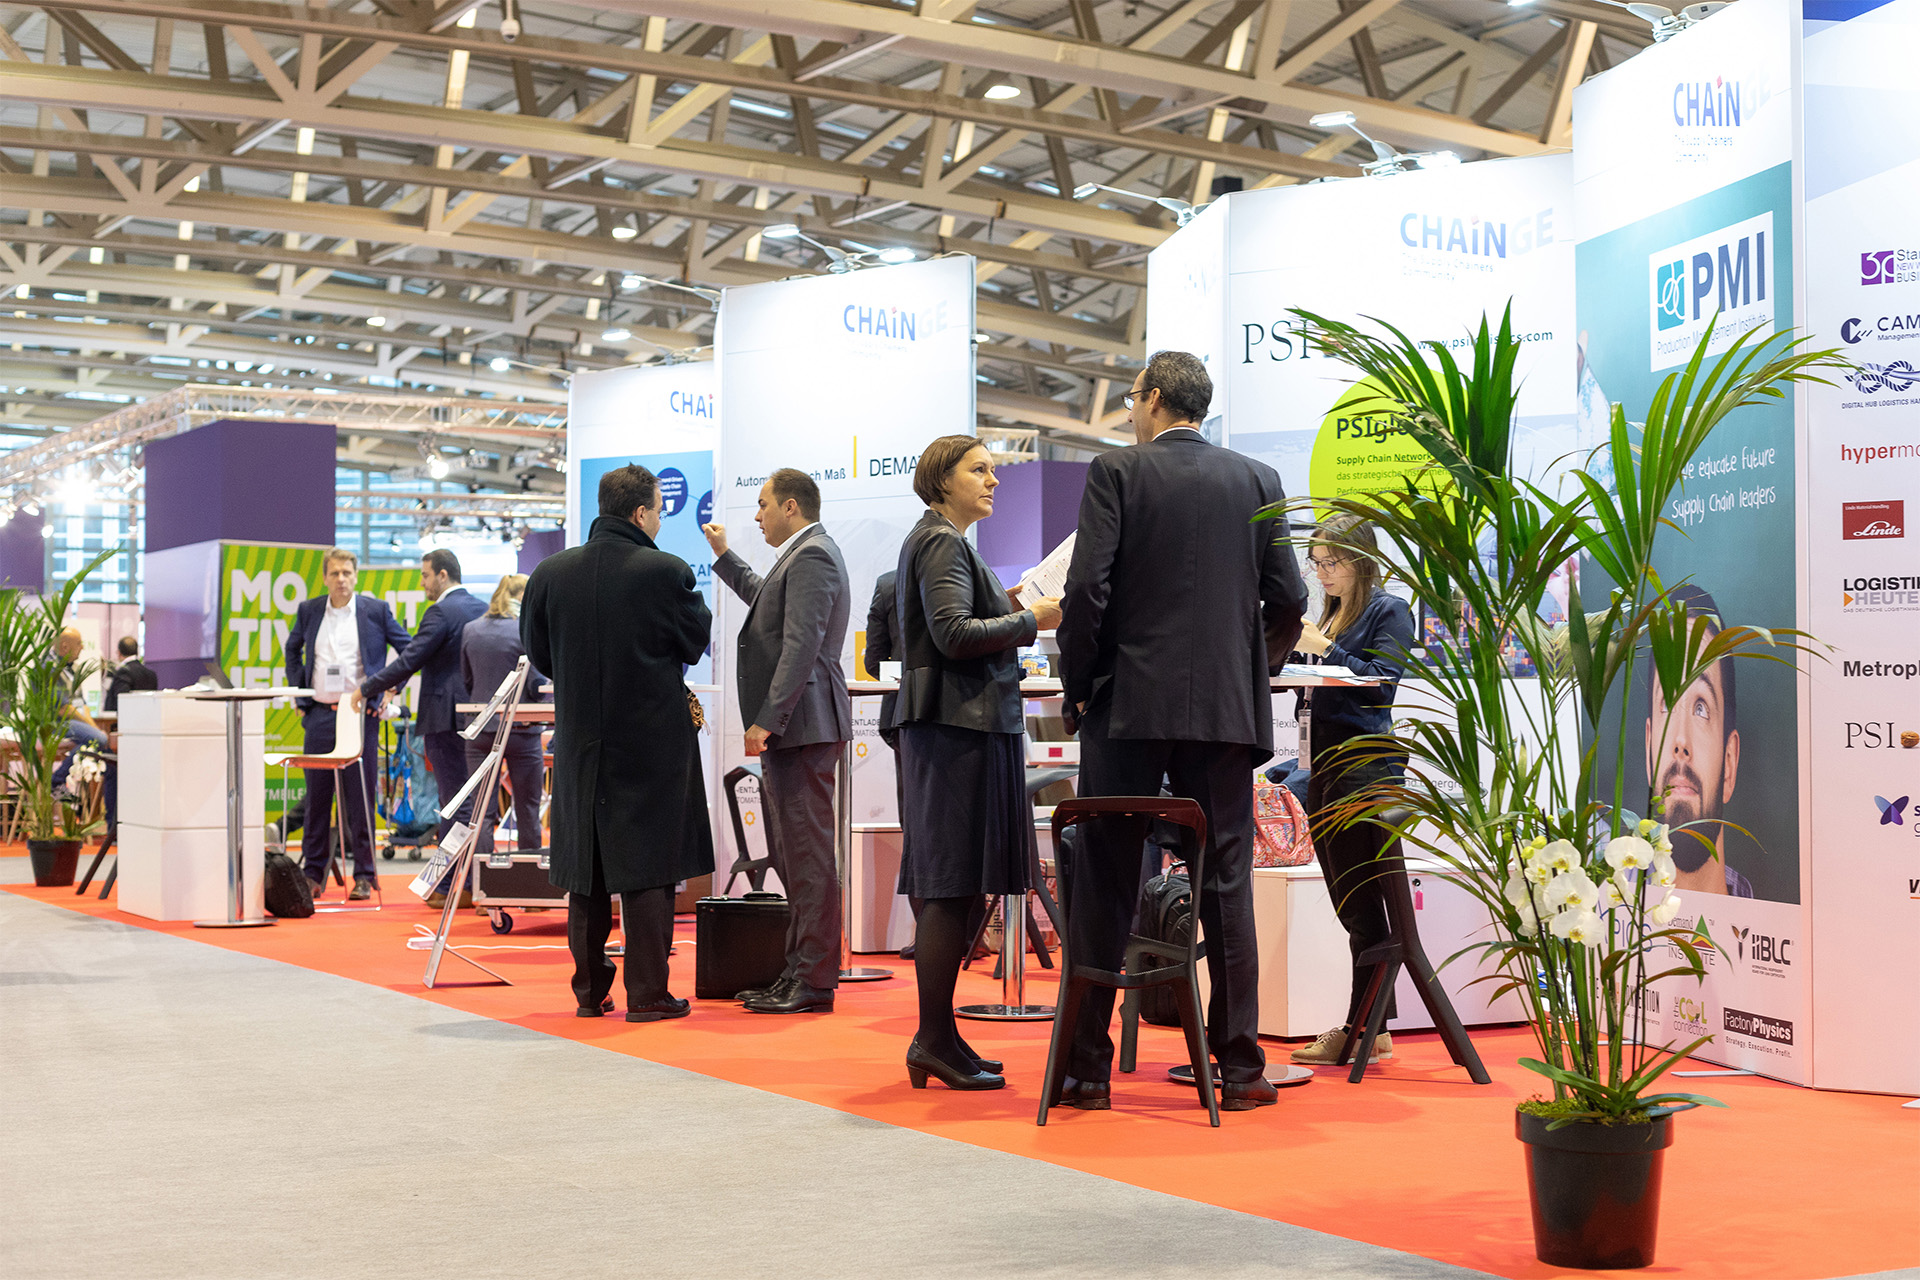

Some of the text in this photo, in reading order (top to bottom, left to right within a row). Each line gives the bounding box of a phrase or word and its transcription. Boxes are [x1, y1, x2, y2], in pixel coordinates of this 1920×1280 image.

[1692, 231, 1765, 321] PMI
[1692, 320, 1737, 346] Magement
[1842, 402, 1864, 410] DIGITAL
[1879, 398, 1909, 407] LOGISTICS
[870, 455, 921, 477] DEMA
[1337, 456, 1365, 467] Supply
[1367, 454, 1391, 463] Chain
[1699, 454, 1737, 479] educate
[1742, 446, 1775, 469] future
[825, 468, 847, 480] Maß
[1337, 471, 1351, 481] das
[1672, 485, 1776, 527] Supply Chain leaders
[1853, 520, 1902, 537] Linde
[1843, 576, 1920, 592] LOGISTI
[1855, 591, 1919, 605] HEUTE
[1845, 721, 1896, 749] PSI
[1674, 1020, 1708, 1037] connection
[1725, 1010, 1791, 1040] FactoryPhysics
